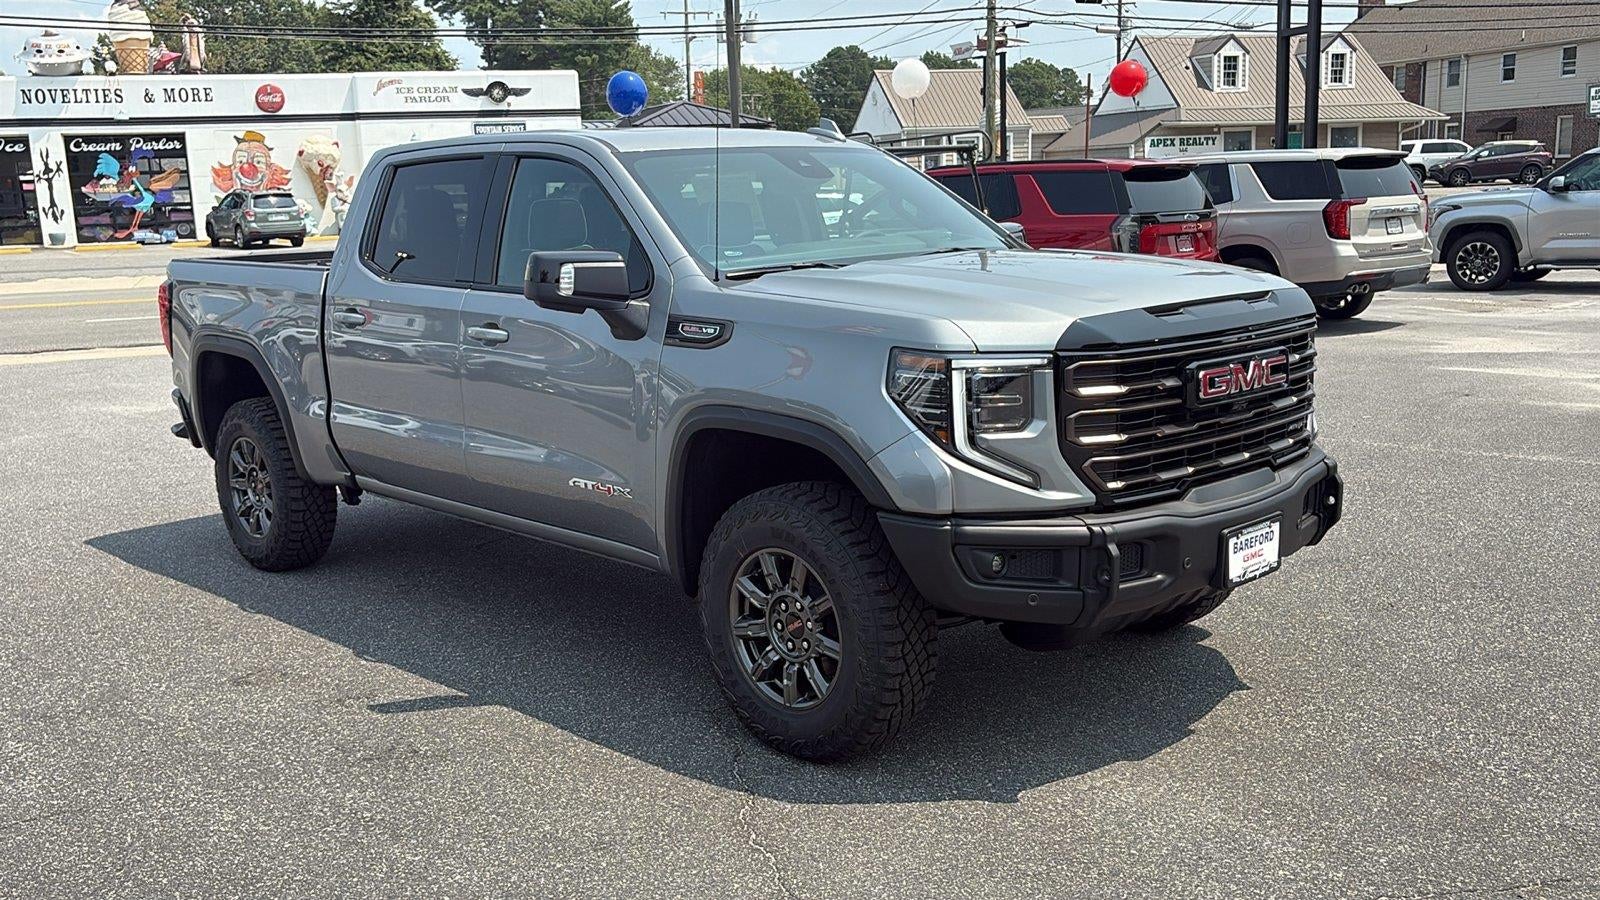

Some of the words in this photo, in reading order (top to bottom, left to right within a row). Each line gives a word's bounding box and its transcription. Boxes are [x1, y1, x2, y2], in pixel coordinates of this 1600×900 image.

[20, 88, 124, 105] NOVELTIES
[143, 88, 155, 104] &
[163, 87, 214, 103] MORE
[395, 86, 414, 94] ICE
[417, 85, 459, 93] CREAM
[502, 124, 526, 132] SERVICE
[69, 138, 122, 152] Cream
[129, 137, 182, 151] Parlor
[1149, 138, 1176, 148] APEX
[1178, 136, 1217, 147] REALTY
[1199, 355, 1287, 398] GMC
[569, 477, 632, 498] AT4X
[1233, 530, 1274, 554] BAREFORD
[1242, 548, 1264, 562] GMC
